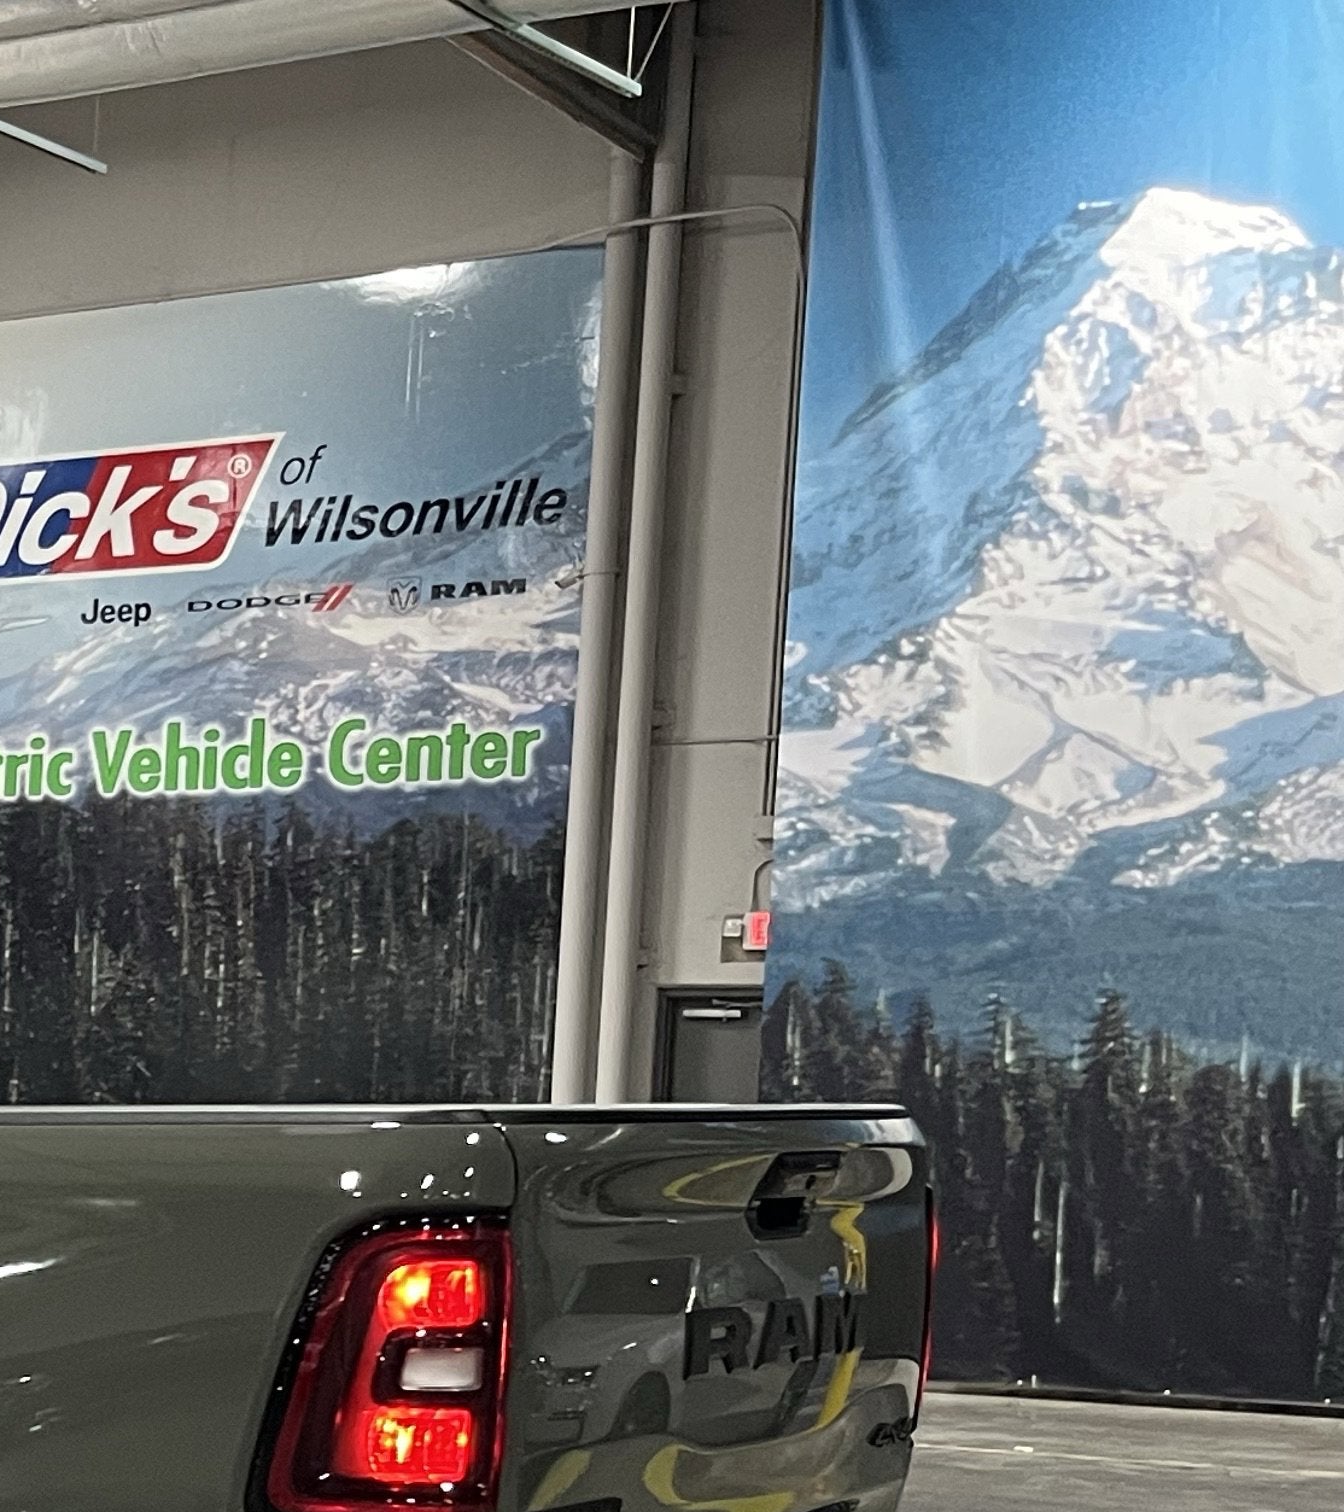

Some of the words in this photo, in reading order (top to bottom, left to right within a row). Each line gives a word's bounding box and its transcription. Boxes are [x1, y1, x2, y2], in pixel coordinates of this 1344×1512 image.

[279, 444, 328, 486] of
[264, 473, 569, 547] Wilsonville
[80, 598, 152, 627] Jeep
[187, 592, 331, 612] DODGE
[431, 578, 526, 601] RAM
[92, 718, 304, 794] Vehicle
[328, 718, 542, 787] Center
[682, 1291, 863, 1381] RAM
